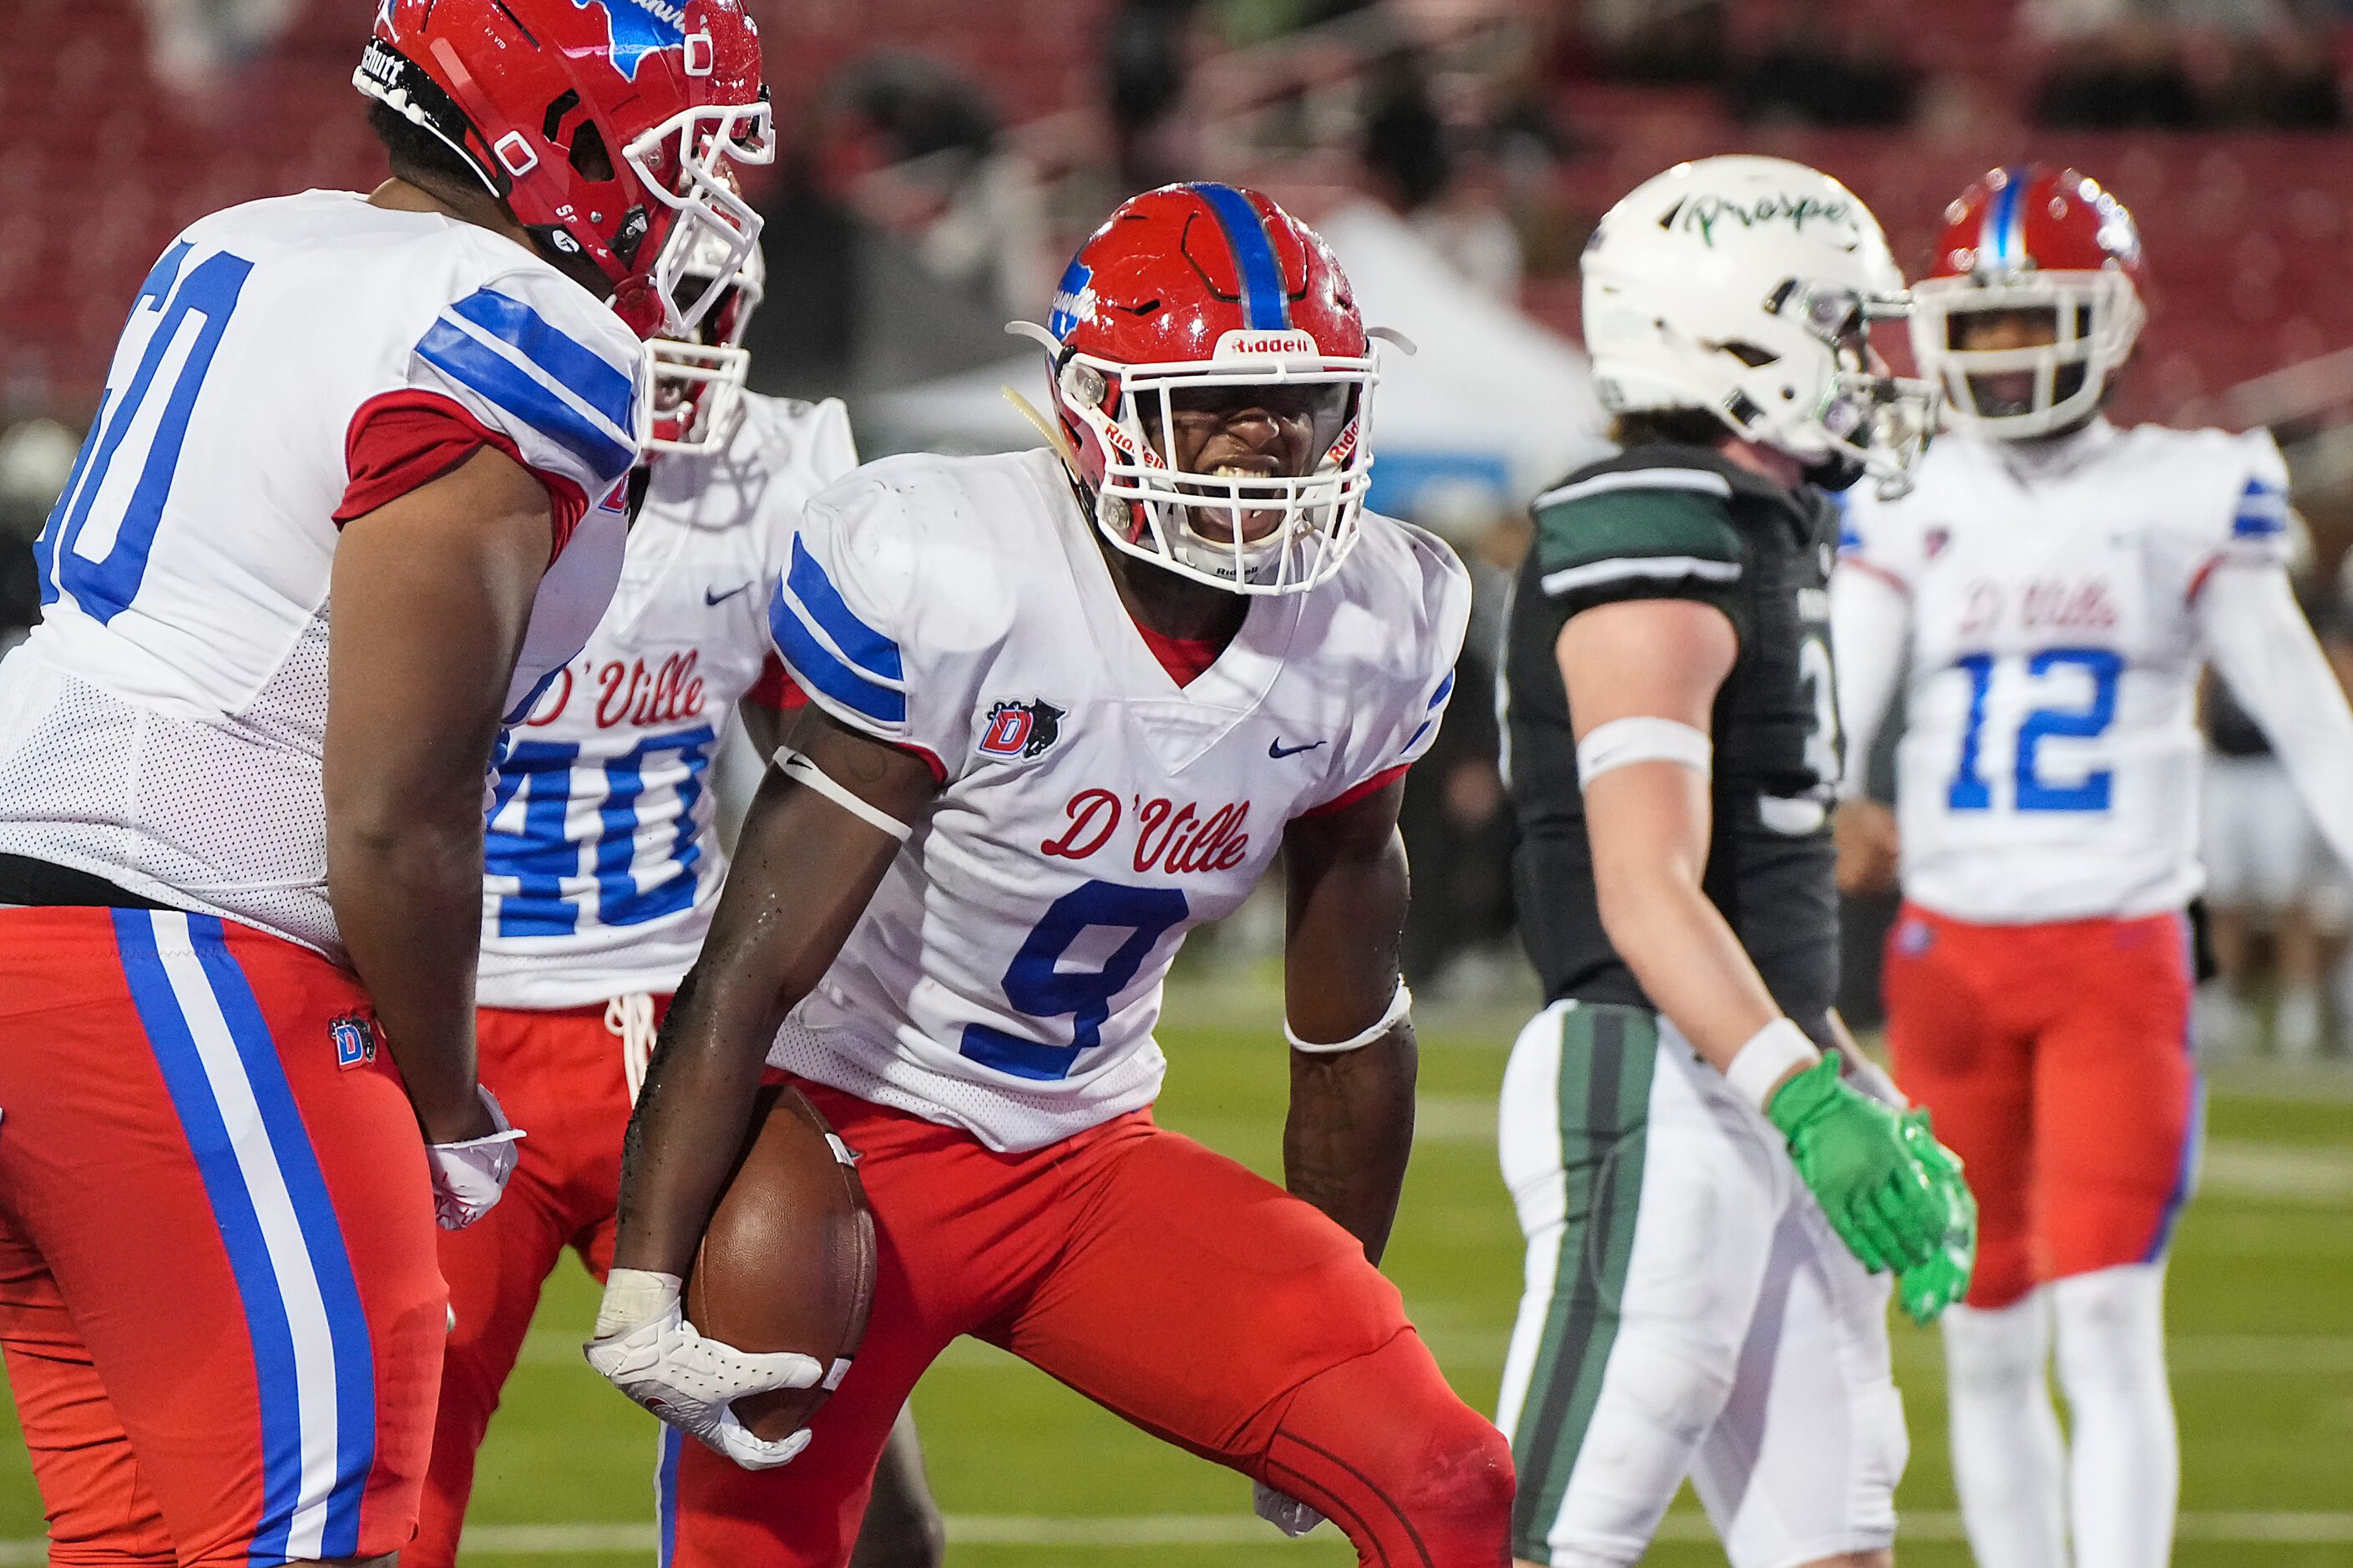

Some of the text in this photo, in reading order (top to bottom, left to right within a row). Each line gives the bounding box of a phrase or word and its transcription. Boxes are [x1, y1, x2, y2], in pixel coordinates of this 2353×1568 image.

[1232, 337, 1309, 352] Riddell
[1105, 422, 1165, 469] Ridell
[1328, 421, 1359, 463] Ridd
[1217, 566, 1258, 576] Ridell
[979, 708, 1034, 756] D
[1948, 646, 2126, 812] 12
[483, 724, 715, 937] 40
[1040, 787, 1250, 874] D'Ville
[959, 879, 1190, 1080] 9
[335, 1024, 363, 1066] D
